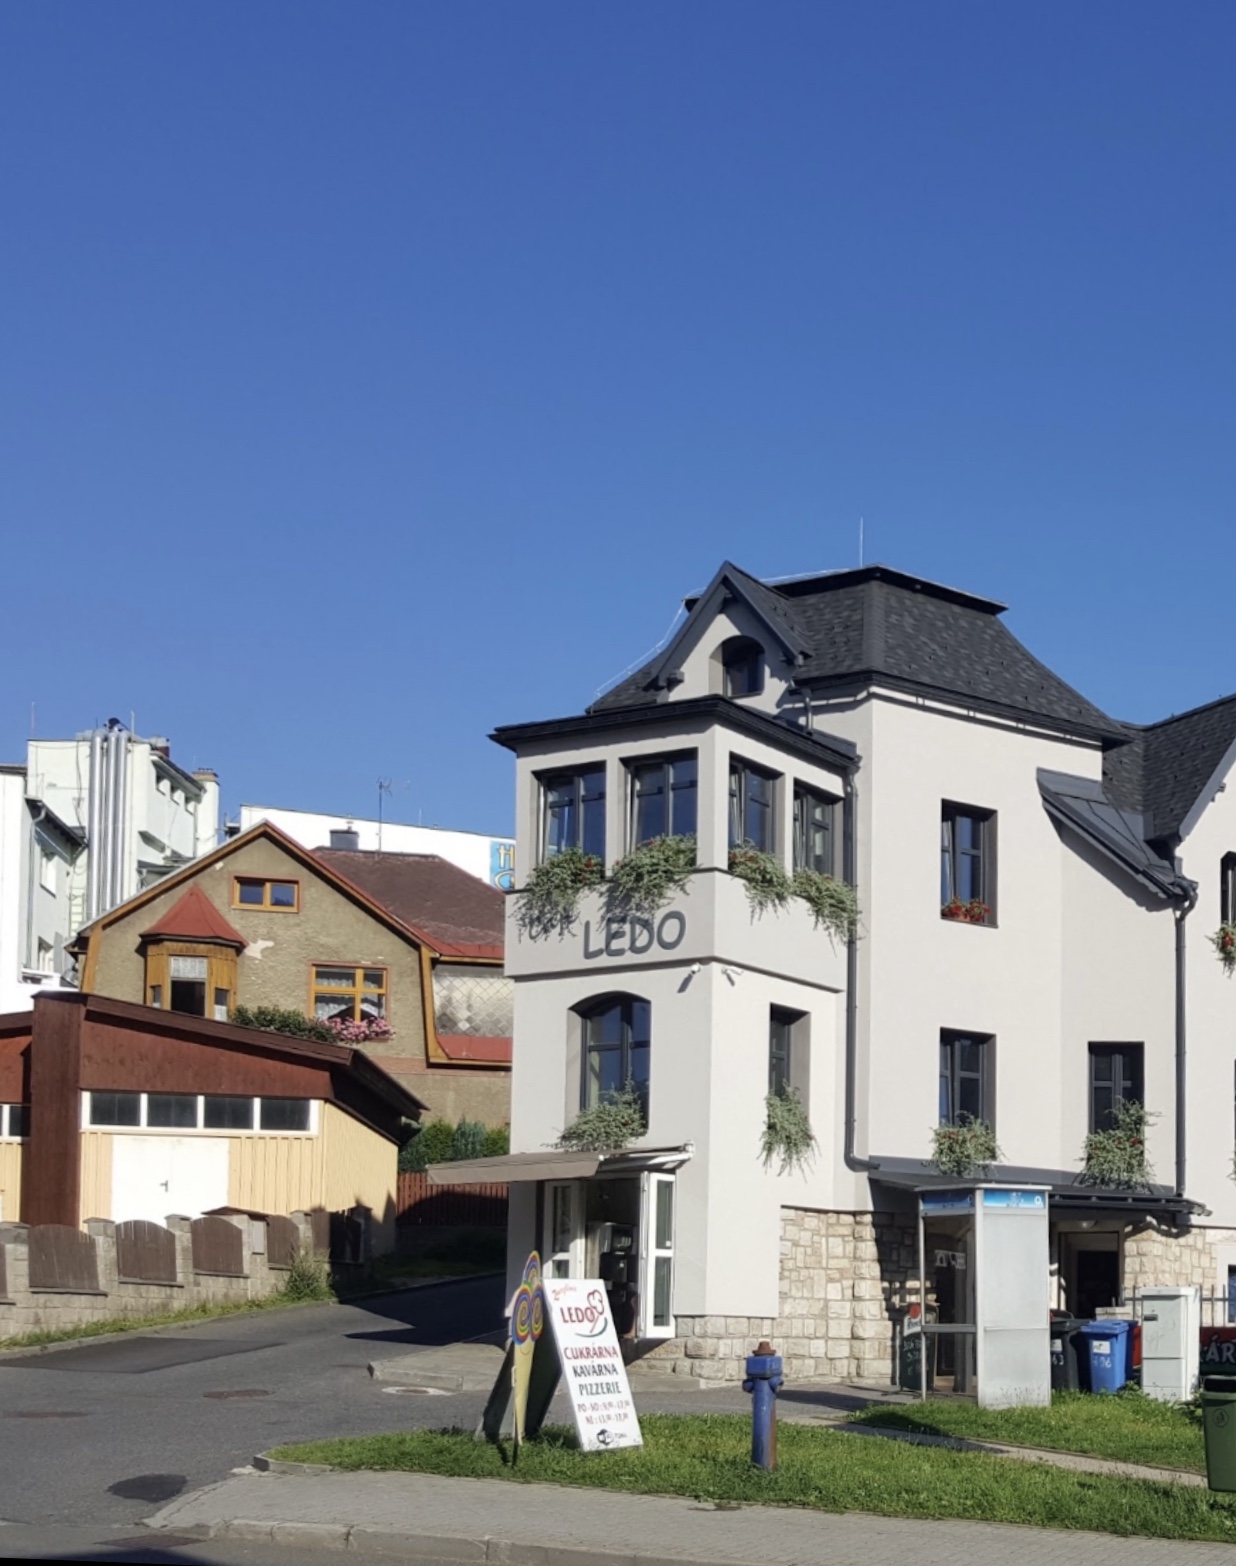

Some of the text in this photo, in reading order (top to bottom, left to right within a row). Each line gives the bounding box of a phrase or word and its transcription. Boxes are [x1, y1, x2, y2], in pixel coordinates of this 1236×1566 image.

[583, 910, 687, 960] LEDO
[560, 1306, 596, 1324] LEDO
[563, 1341, 619, 1360] CUKRÁRNA
[572, 1360, 619, 1378] KAVÁRNA
[578, 1381, 622, 1397] PIZZERIE
